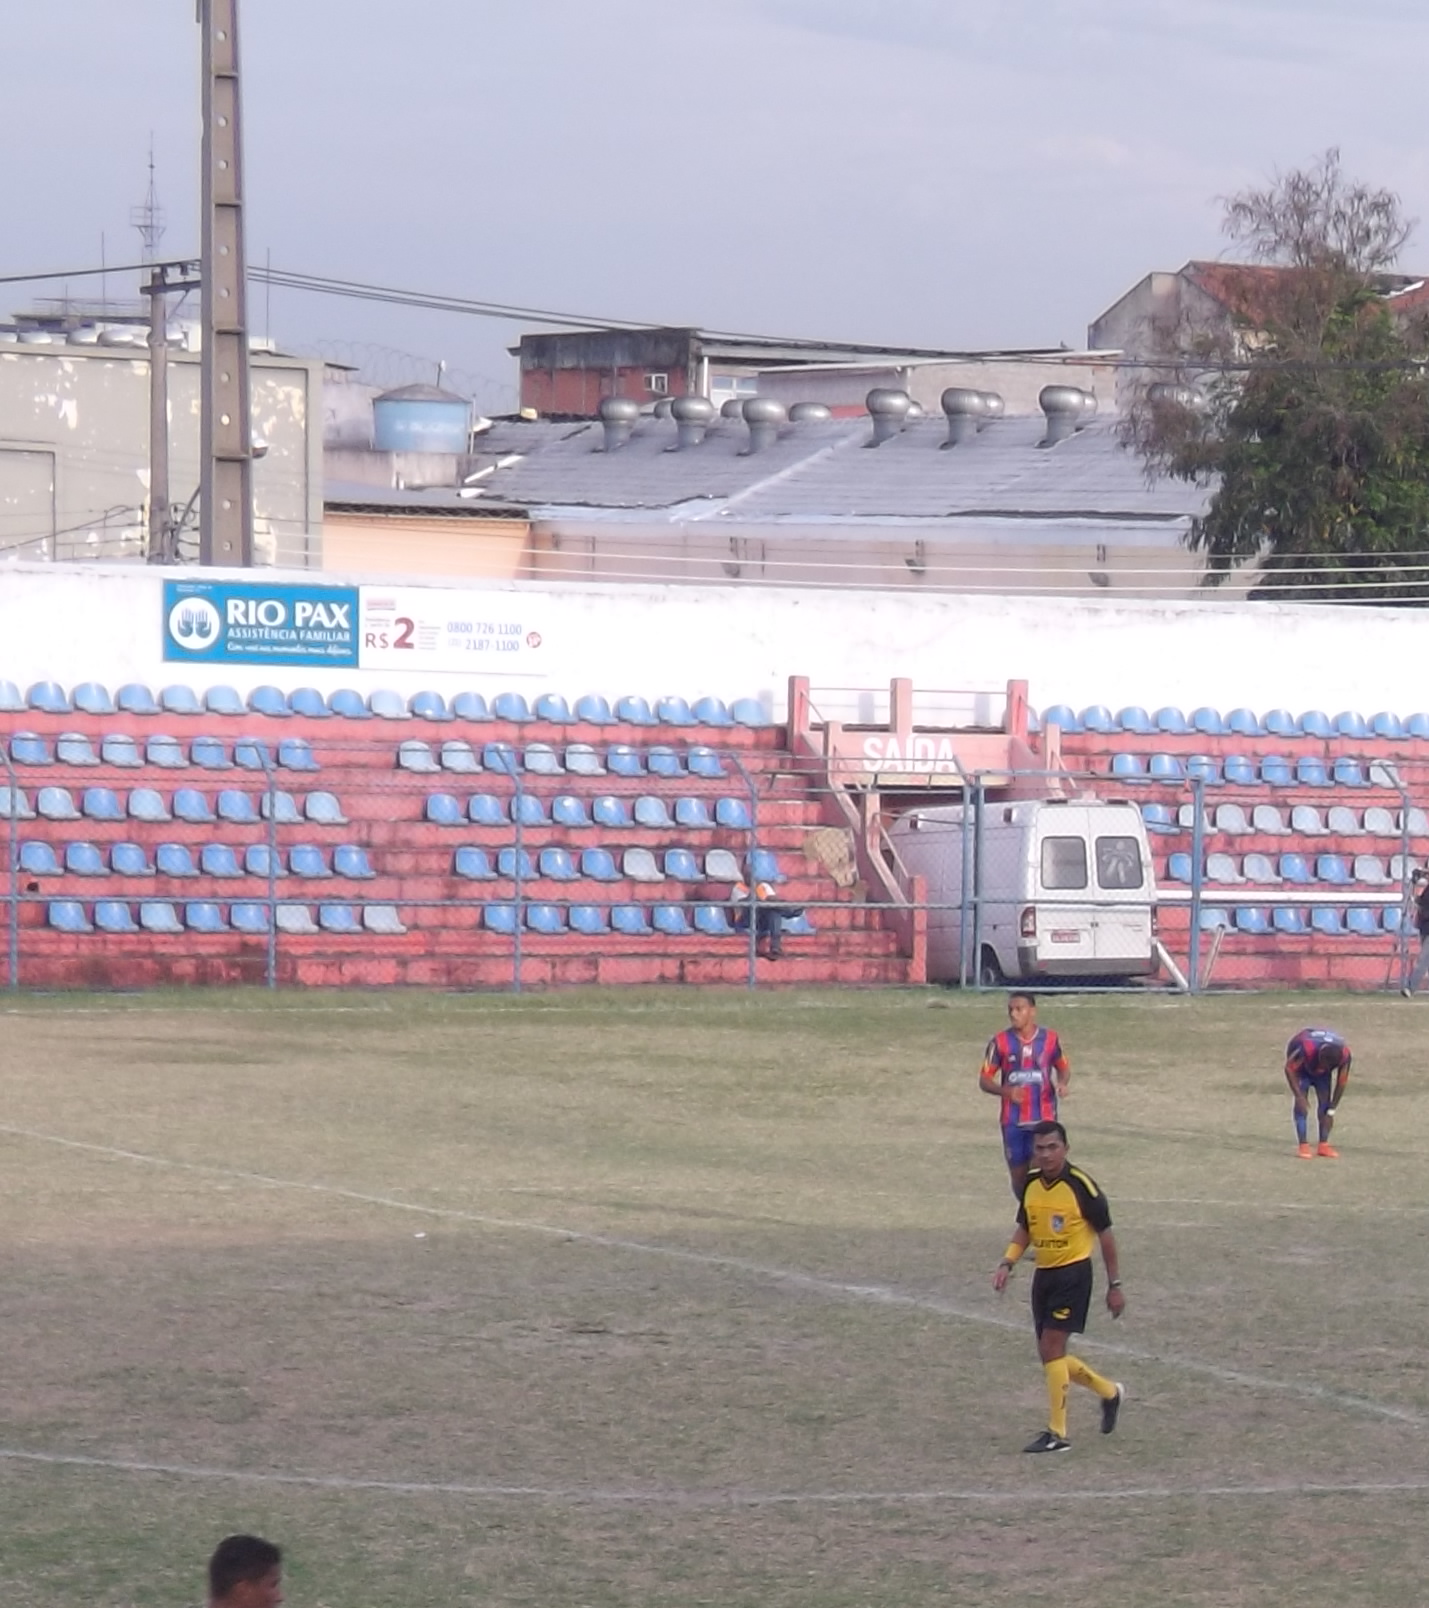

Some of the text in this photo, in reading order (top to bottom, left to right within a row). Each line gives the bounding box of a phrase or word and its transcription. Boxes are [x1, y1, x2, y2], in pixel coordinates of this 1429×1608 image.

[227, 599, 286, 627] RIO
[294, 602, 350, 629] PAX
[447, 622, 522, 636] 0800 726 1100
[227, 627, 350, 642] ASSISTÊNCIA FAMILIAR
[365, 632, 389, 649] R$
[393, 617, 415, 649] 2
[862, 734, 956, 772] SAÍDA
